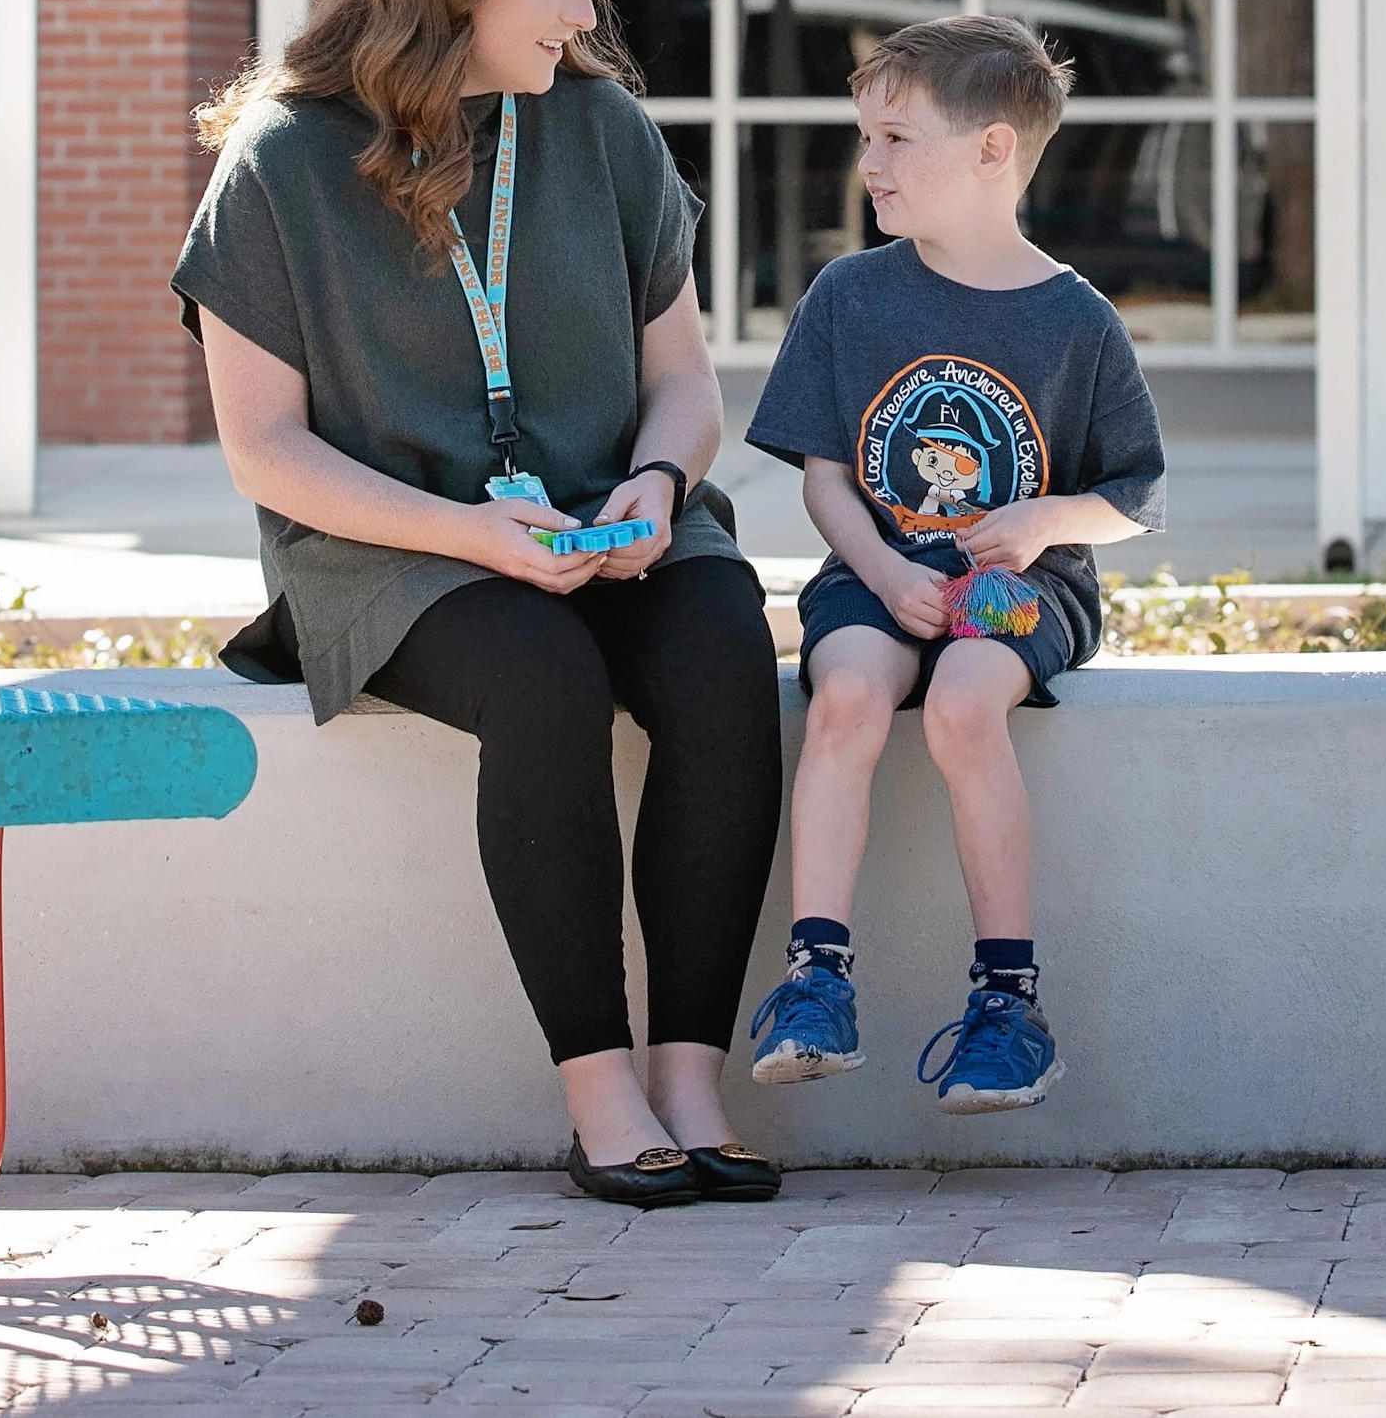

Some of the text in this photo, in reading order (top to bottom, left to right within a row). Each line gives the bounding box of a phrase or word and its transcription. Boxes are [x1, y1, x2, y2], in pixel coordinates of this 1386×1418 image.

[503, 113, 514, 143] BE
[496, 147, 513, 189] THE
[490, 194, 509, 287] ANCHOR
[470, 295, 494, 340] THE
[484, 342, 502, 373] BE
[871, 368, 936, 432] Treasure,
[939, 361, 1023, 419] Anchored
[940, 404, 960, 424] FV
[1013, 417, 1027, 440] in
[865, 436, 884, 482] Local
[906, 530, 956, 545] Elemen
